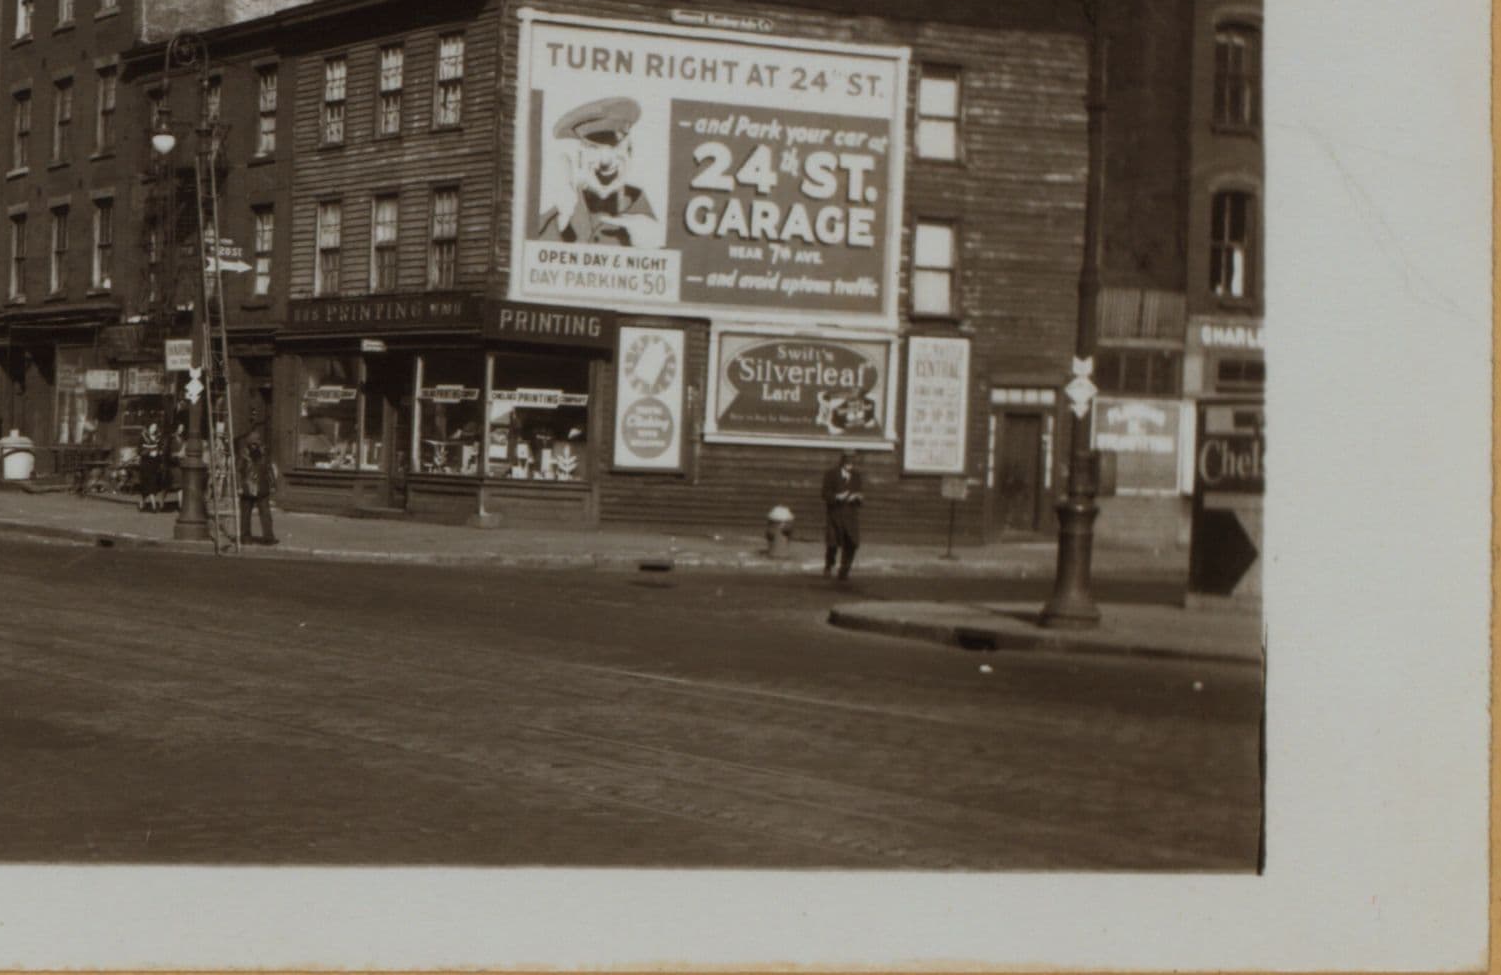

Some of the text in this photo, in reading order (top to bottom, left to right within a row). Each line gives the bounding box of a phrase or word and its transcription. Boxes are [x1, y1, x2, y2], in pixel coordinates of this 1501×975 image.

[546, 42, 635, 75] TURN
[645, 53, 739, 86] RIGHT
[746, 63, 780, 89] AT
[846, 73, 885, 99] ST.
[694, 115, 734, 136] and
[734, 115, 784, 140] Park
[786, 126, 832, 146] your
[834, 131, 869, 148] car
[868, 135, 889, 154] at
[801, 150, 879, 203] ST.
[684, 195, 875, 248] GARAGE
[538, 249, 578, 265] OPEN
[583, 252, 609, 266] DAY
[626, 256, 668, 271] NIGHT
[728, 245, 763, 261] NEAR
[530, 268, 667, 295] DAY PARKING 50
[324, 300, 423, 323] PRINTING
[500, 308, 601, 338] PRINTING
[777, 345, 835, 362] Swift's
[738, 357, 868, 388] Silverleaf
[762, 384, 800, 402] Lard
